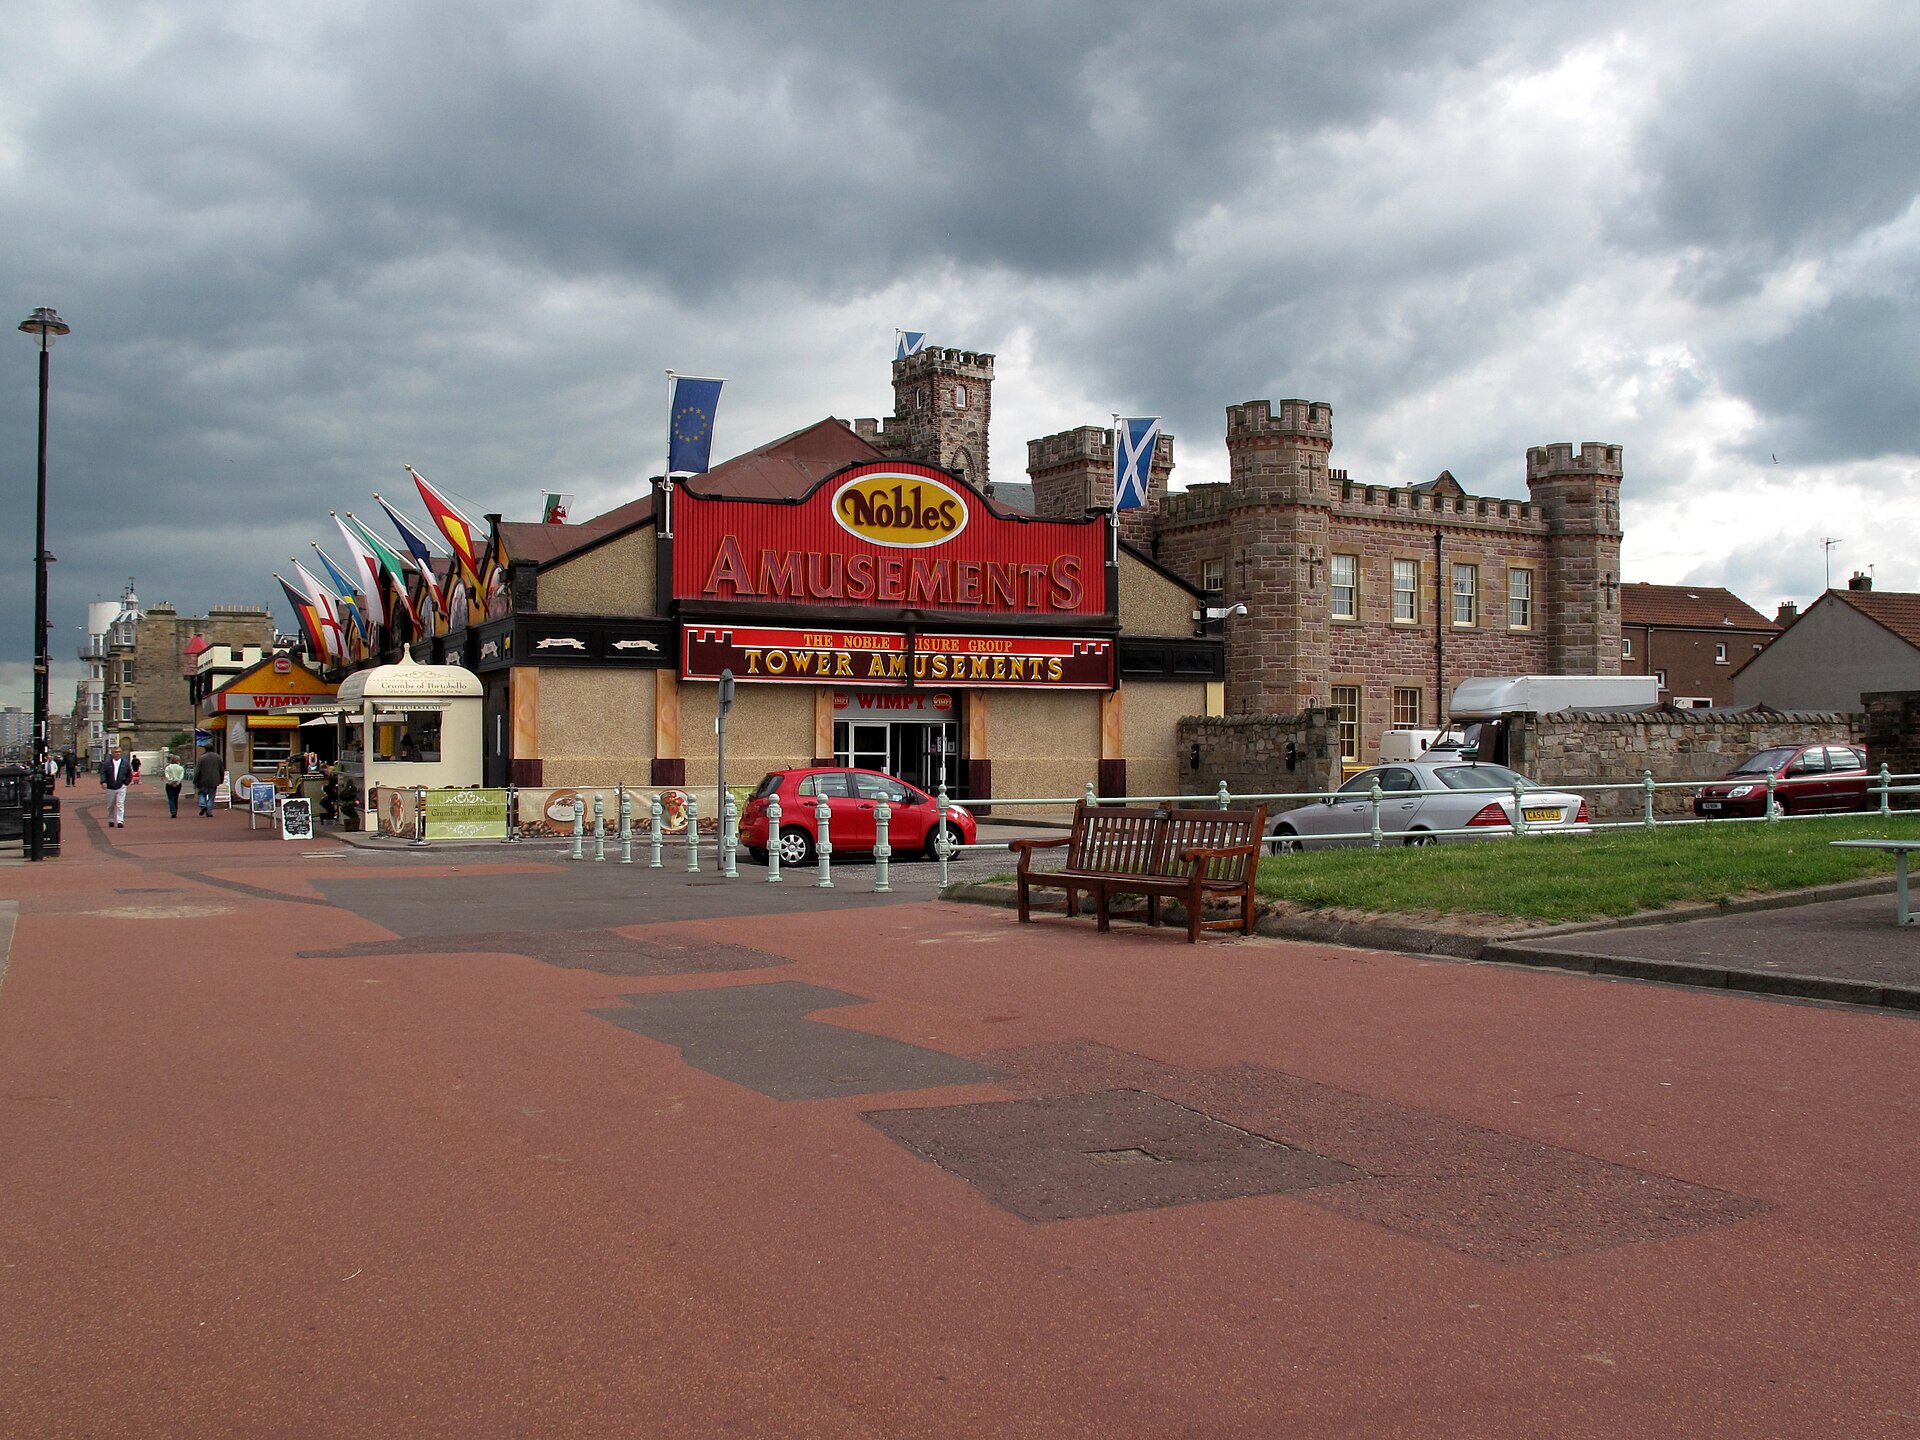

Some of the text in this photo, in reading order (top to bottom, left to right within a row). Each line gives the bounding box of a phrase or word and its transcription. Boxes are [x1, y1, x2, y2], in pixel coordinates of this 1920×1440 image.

[841, 485, 957, 532] Nobles
[703, 534, 1084, 610] AMUSEMENTS
[803, 634, 833, 647] THE
[842, 636, 890, 649] NOBLE
[968, 640, 1013, 653] GROUP
[745, 650, 1063, 681] TOWER AMUSEMENTS
[253, 695, 311, 708] WIMPY
[853, 692, 926, 710] WIMPY
[932, 697, 953, 705] WIMPY
[431, 806, 501, 817] Crumbs of Portobello
